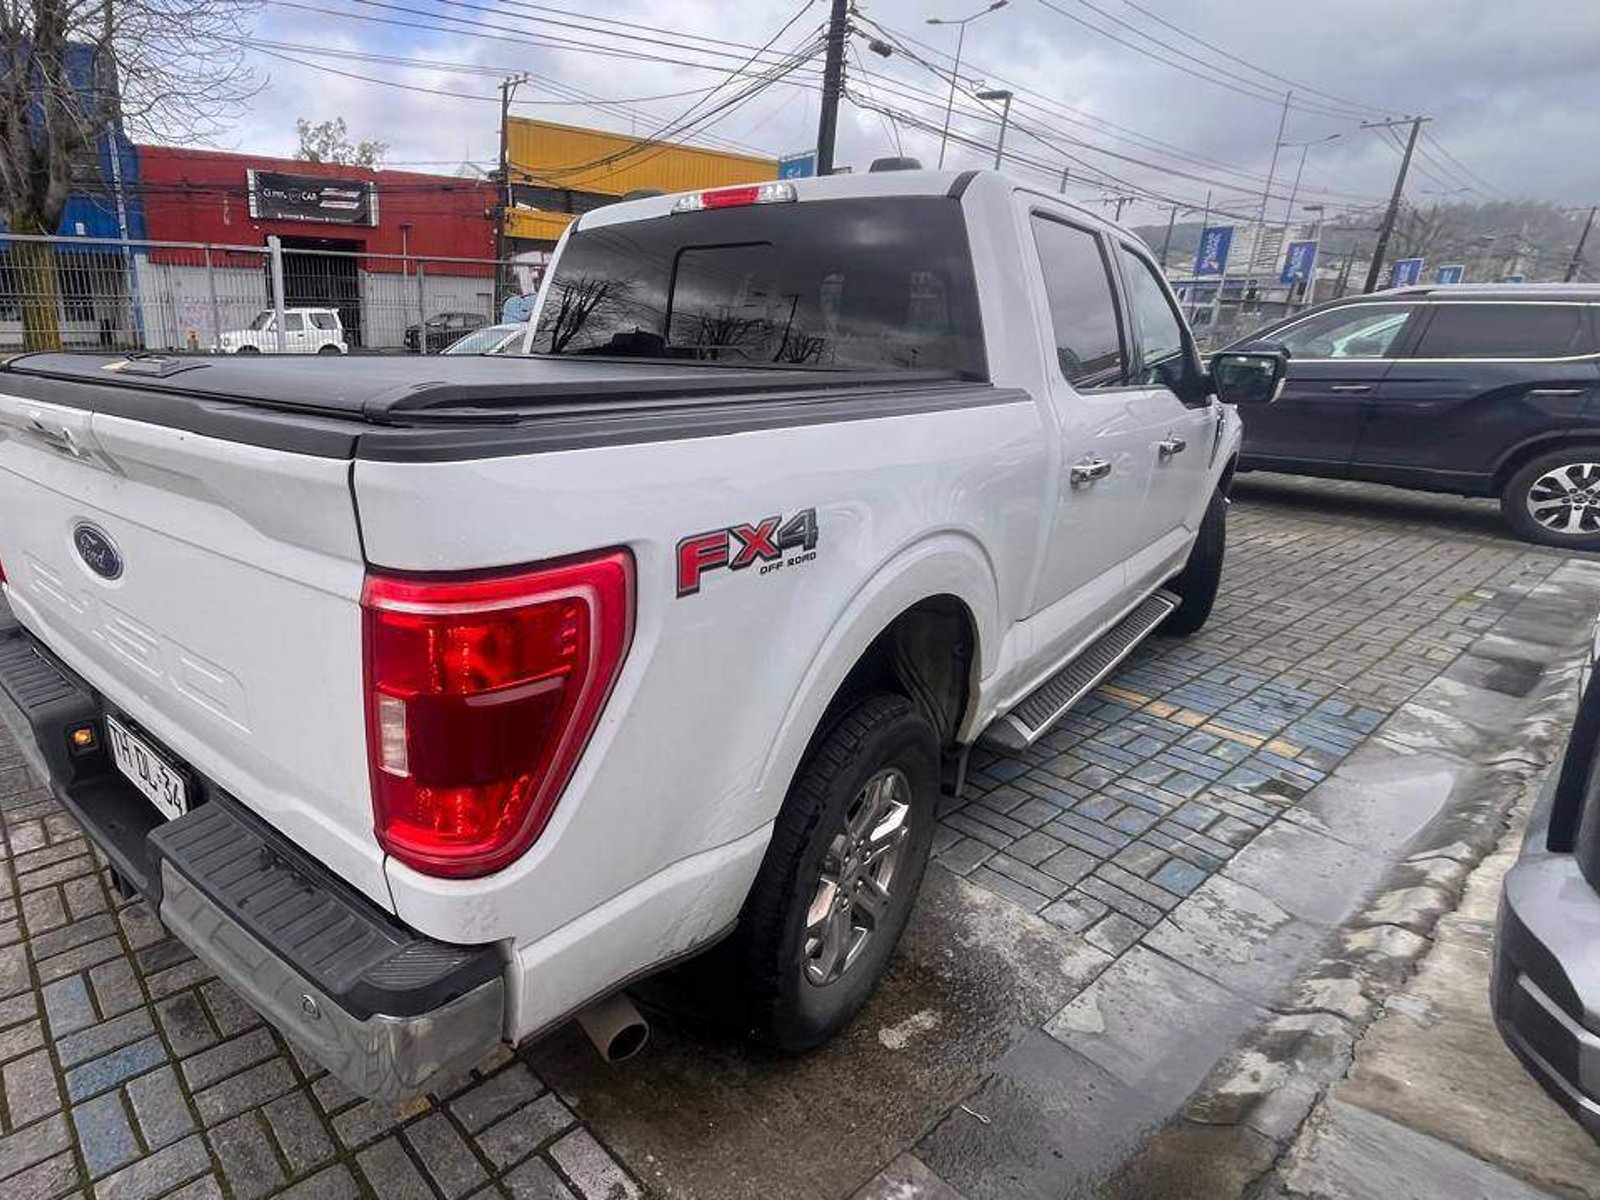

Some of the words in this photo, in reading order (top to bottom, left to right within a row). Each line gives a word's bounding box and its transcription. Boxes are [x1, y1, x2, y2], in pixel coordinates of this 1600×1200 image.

[675, 507, 819, 600] FX4
[759, 562, 784, 576] OFF
[786, 551, 817, 568] ROAD
